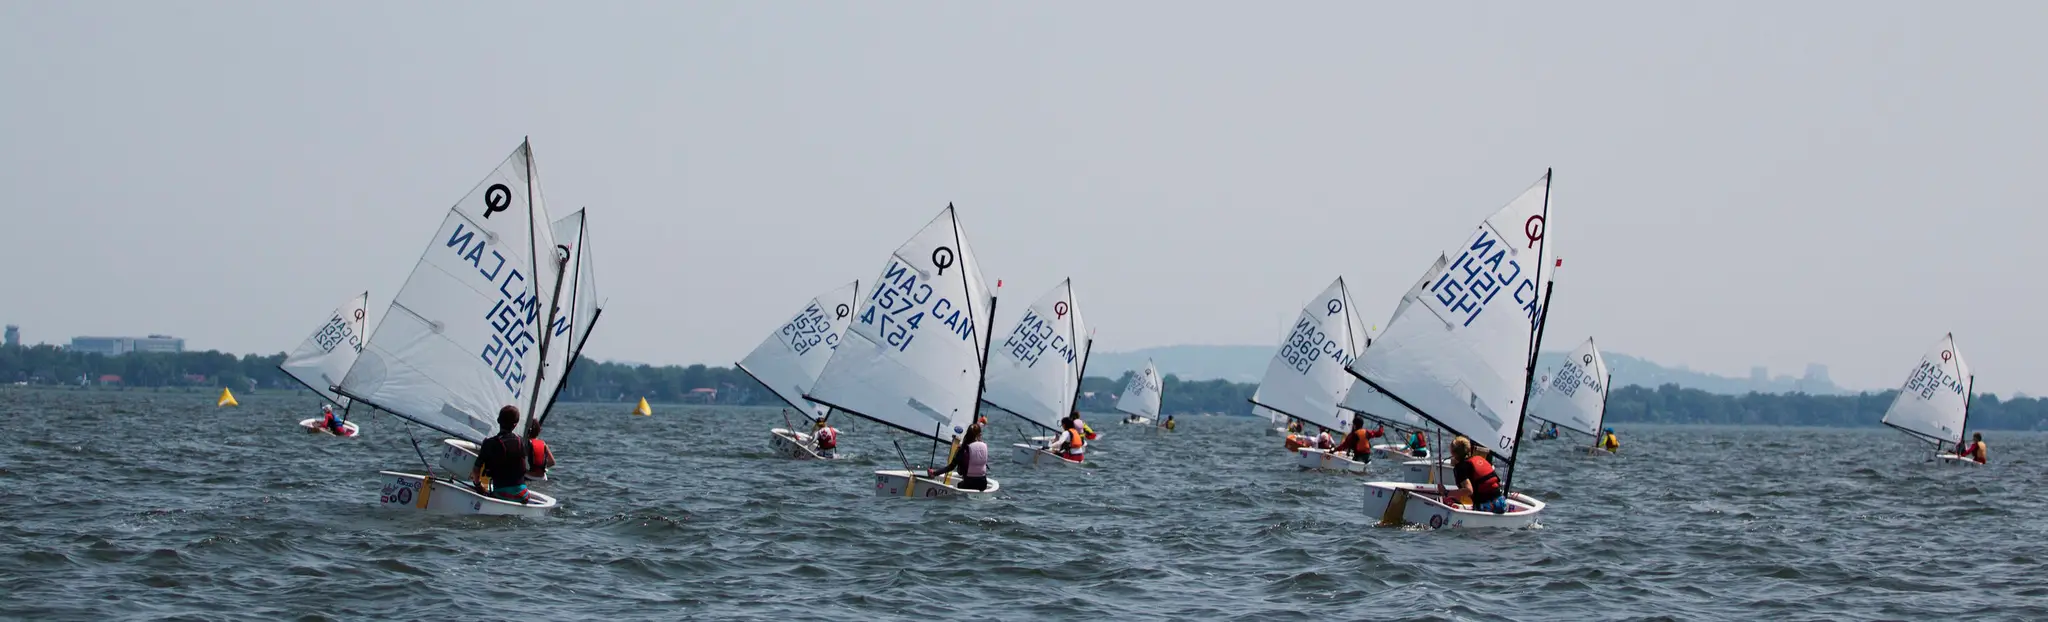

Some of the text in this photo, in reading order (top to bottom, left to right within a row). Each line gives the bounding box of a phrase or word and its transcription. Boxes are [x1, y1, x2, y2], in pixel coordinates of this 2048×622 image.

[1450, 251, 1501, 305] 1421
[872, 282, 925, 330] 1574
[932, 298, 974, 341] CAN
[322, 322, 344, 345] 1321
[793, 313, 822, 347] 1573
[1013, 324, 1048, 356] 1494
[1051, 335, 1076, 364] CAN
[1288, 330, 1320, 362] 1360
[1323, 340, 1353, 367] CAN
[1558, 369, 1581, 388] 1569
[1582, 375, 1601, 393] CAN
[1914, 369, 1940, 391] 1372
[1942, 374, 1962, 395] CAN
